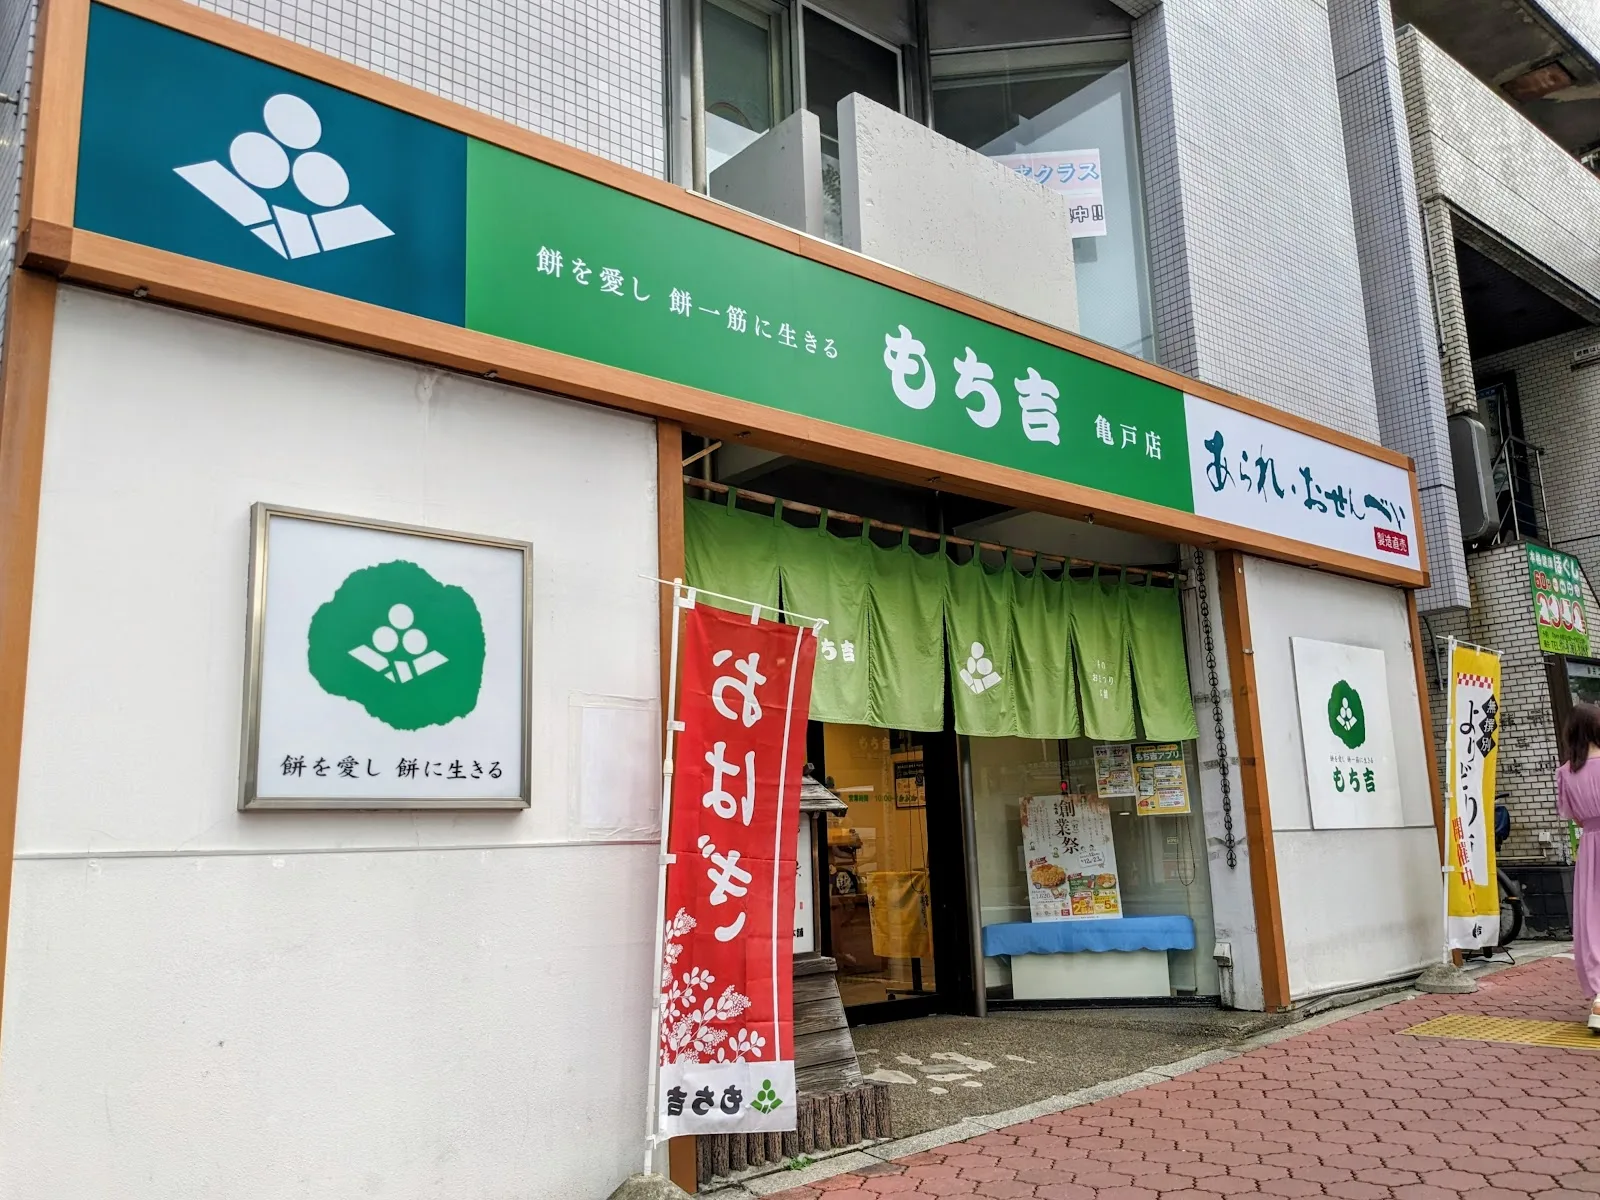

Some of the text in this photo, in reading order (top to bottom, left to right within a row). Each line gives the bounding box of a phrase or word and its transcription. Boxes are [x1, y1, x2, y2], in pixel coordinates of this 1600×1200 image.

[1069, 204, 1104, 223] 中!!
[536, 245, 839, 359] 餅を愛し 餅一筋に生きる
[883, 324, 1162, 460] もち吉 亀戸店
[1376, 532, 1408, 553] 製造直売
[280, 754, 502, 780] 餅を愛し 餅に生きる
[1135, 750, 1179, 761] もち吉アプリ
[1333, 766, 1376, 793] もち吉
[1054, 798, 1080, 854] 創業祭
